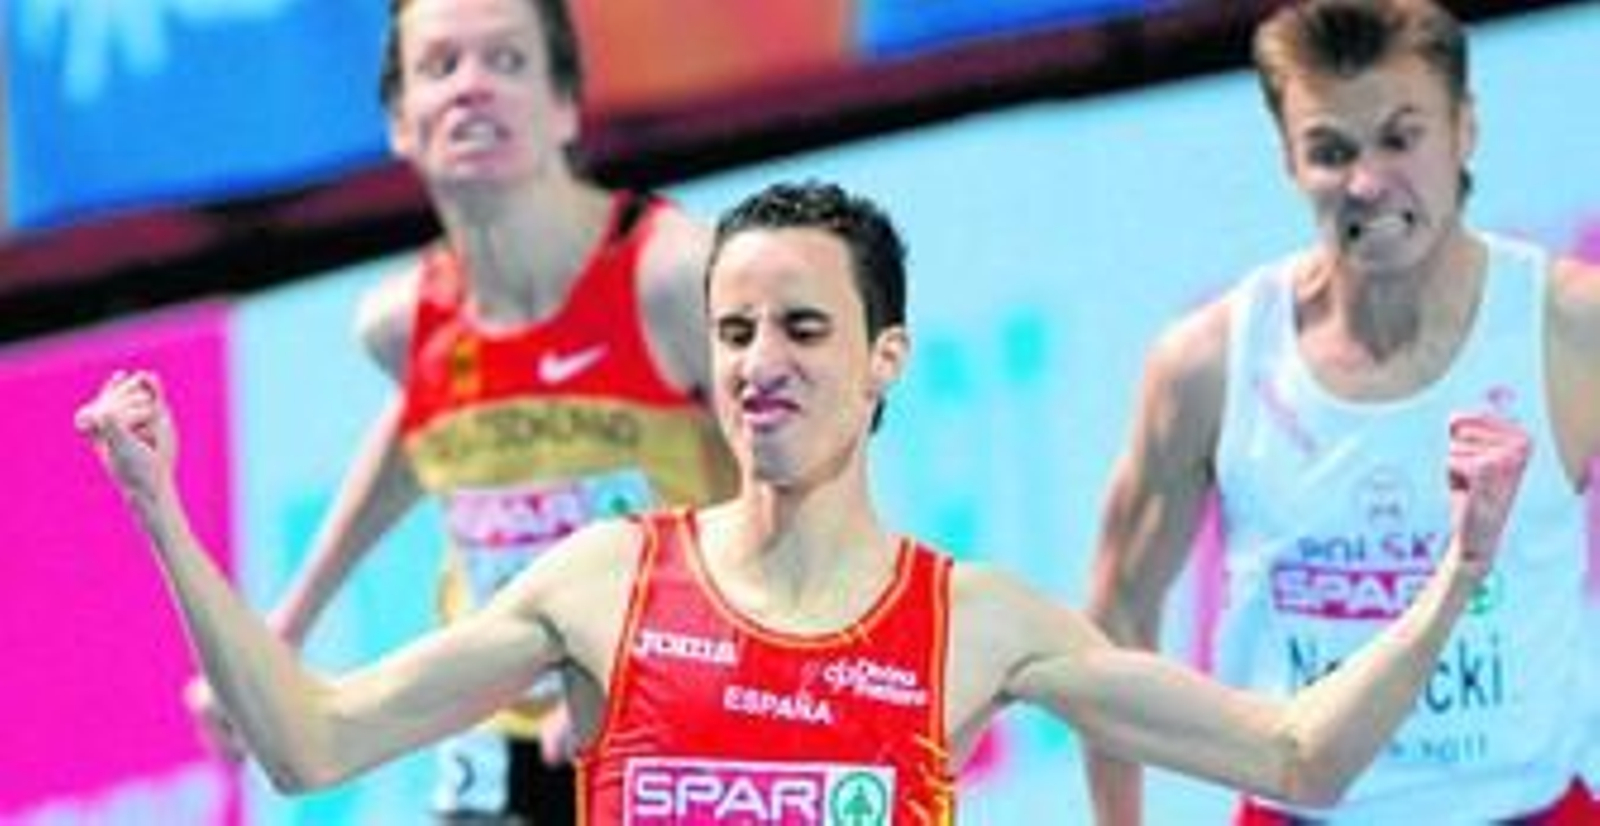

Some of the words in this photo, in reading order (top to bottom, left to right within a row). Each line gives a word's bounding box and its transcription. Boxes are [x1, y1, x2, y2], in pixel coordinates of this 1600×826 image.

[1298, 535, 1438, 562] POLSK
[1289, 632, 1504, 713] Ncki
[722, 686, 834, 724] ESPAÑA
[635, 773, 819, 819] SPAR
